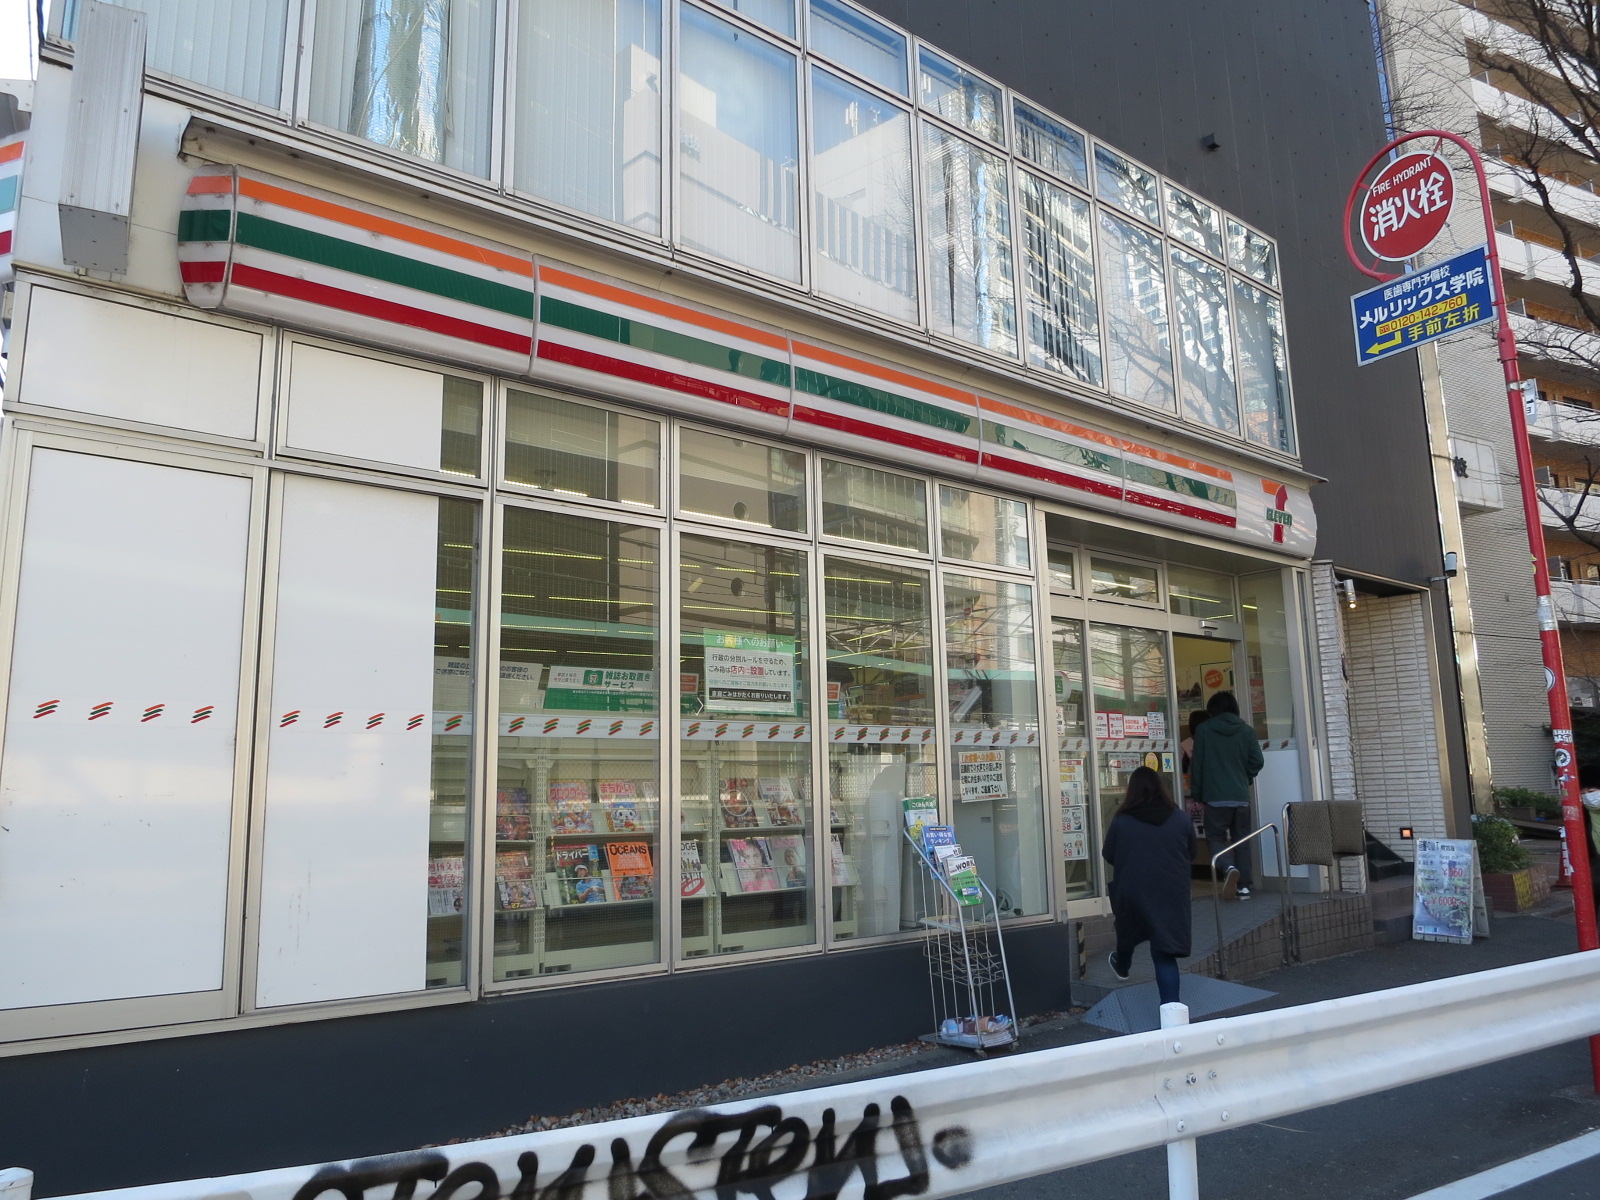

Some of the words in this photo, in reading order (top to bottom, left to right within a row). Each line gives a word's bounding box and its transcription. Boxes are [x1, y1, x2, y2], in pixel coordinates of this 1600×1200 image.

[1372, 180, 1391, 197] FIRE
[1393, 157, 1432, 186] HYDRANT
[1369, 172, 1448, 241] 消火栓
[1359, 267, 1485, 329] メルリックス学院
[1383, 265, 1451, 301] 医歯専門予備校
[1390, 296, 1463, 331] 0120-142-760
[1408, 303, 1480, 341] 手前左折
[716, 634, 784, 648] お客様へのお願い
[604, 680, 635, 689] サービス
[605, 670, 651, 681] 雑誌お取置き
[556, 851, 589, 861] ドライバー
[609, 844, 648, 856] OCEANS
